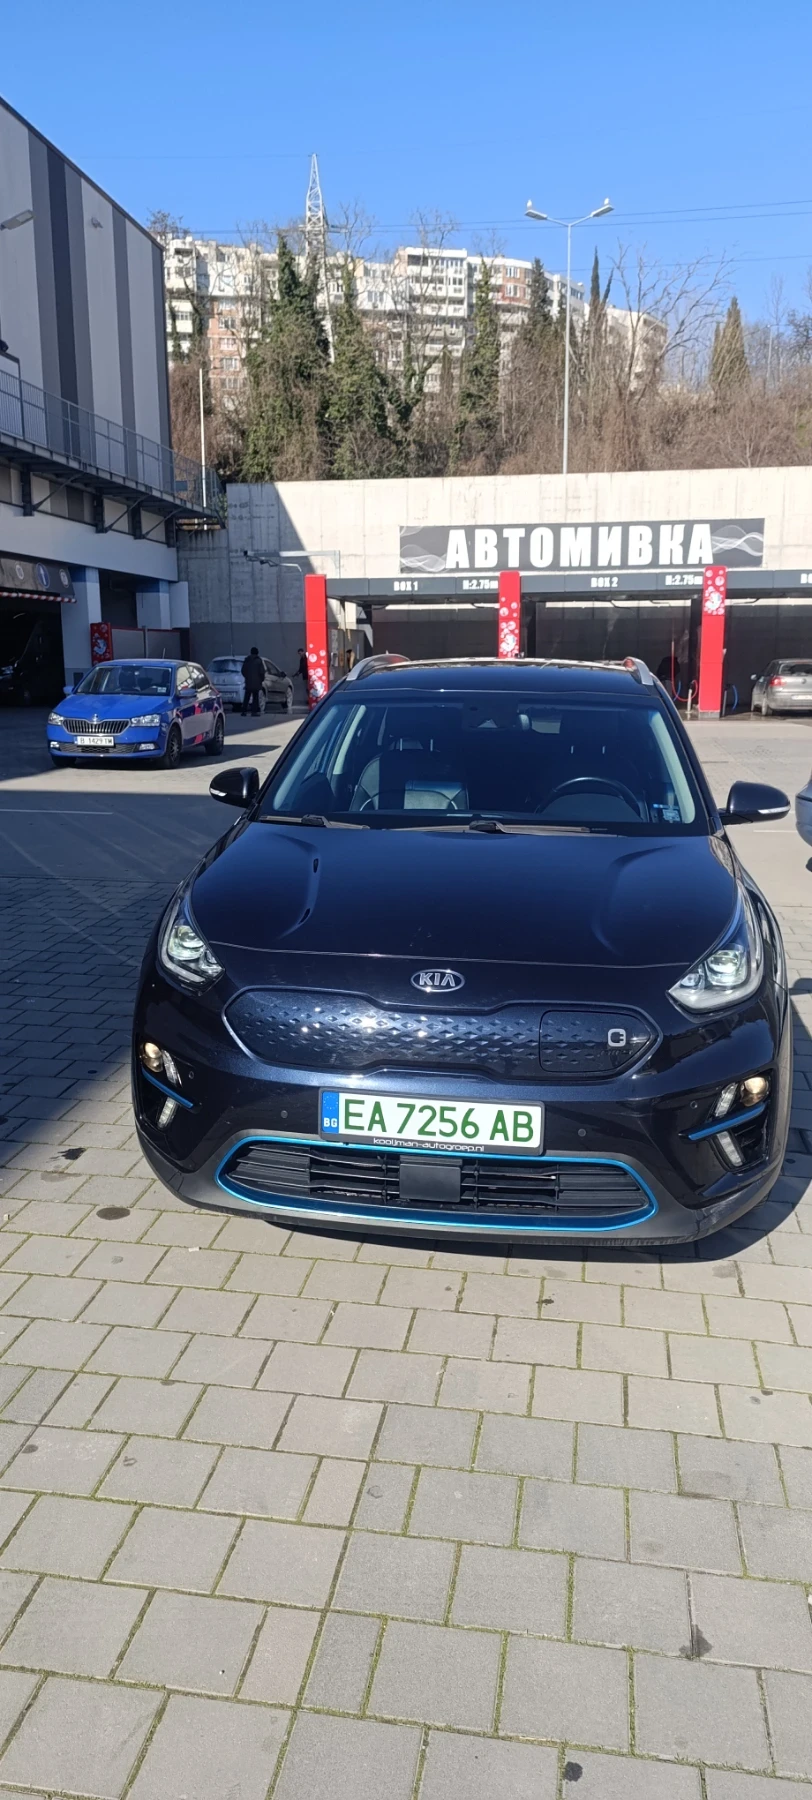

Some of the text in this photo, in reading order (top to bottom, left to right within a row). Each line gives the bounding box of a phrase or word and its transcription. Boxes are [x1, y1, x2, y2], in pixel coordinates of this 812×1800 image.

[445, 523, 714, 569] АВТОМИВКА
[393, 580, 419, 591] BOX 1
[590, 576, 619, 588] BOX 2
[419, 972, 456, 987] KIA
[323, 1117, 338, 1128] BG
[344, 1098, 534, 1143] EA 7256 AB
[373, 1137, 485, 1153] kooijman-autogroep.nl
